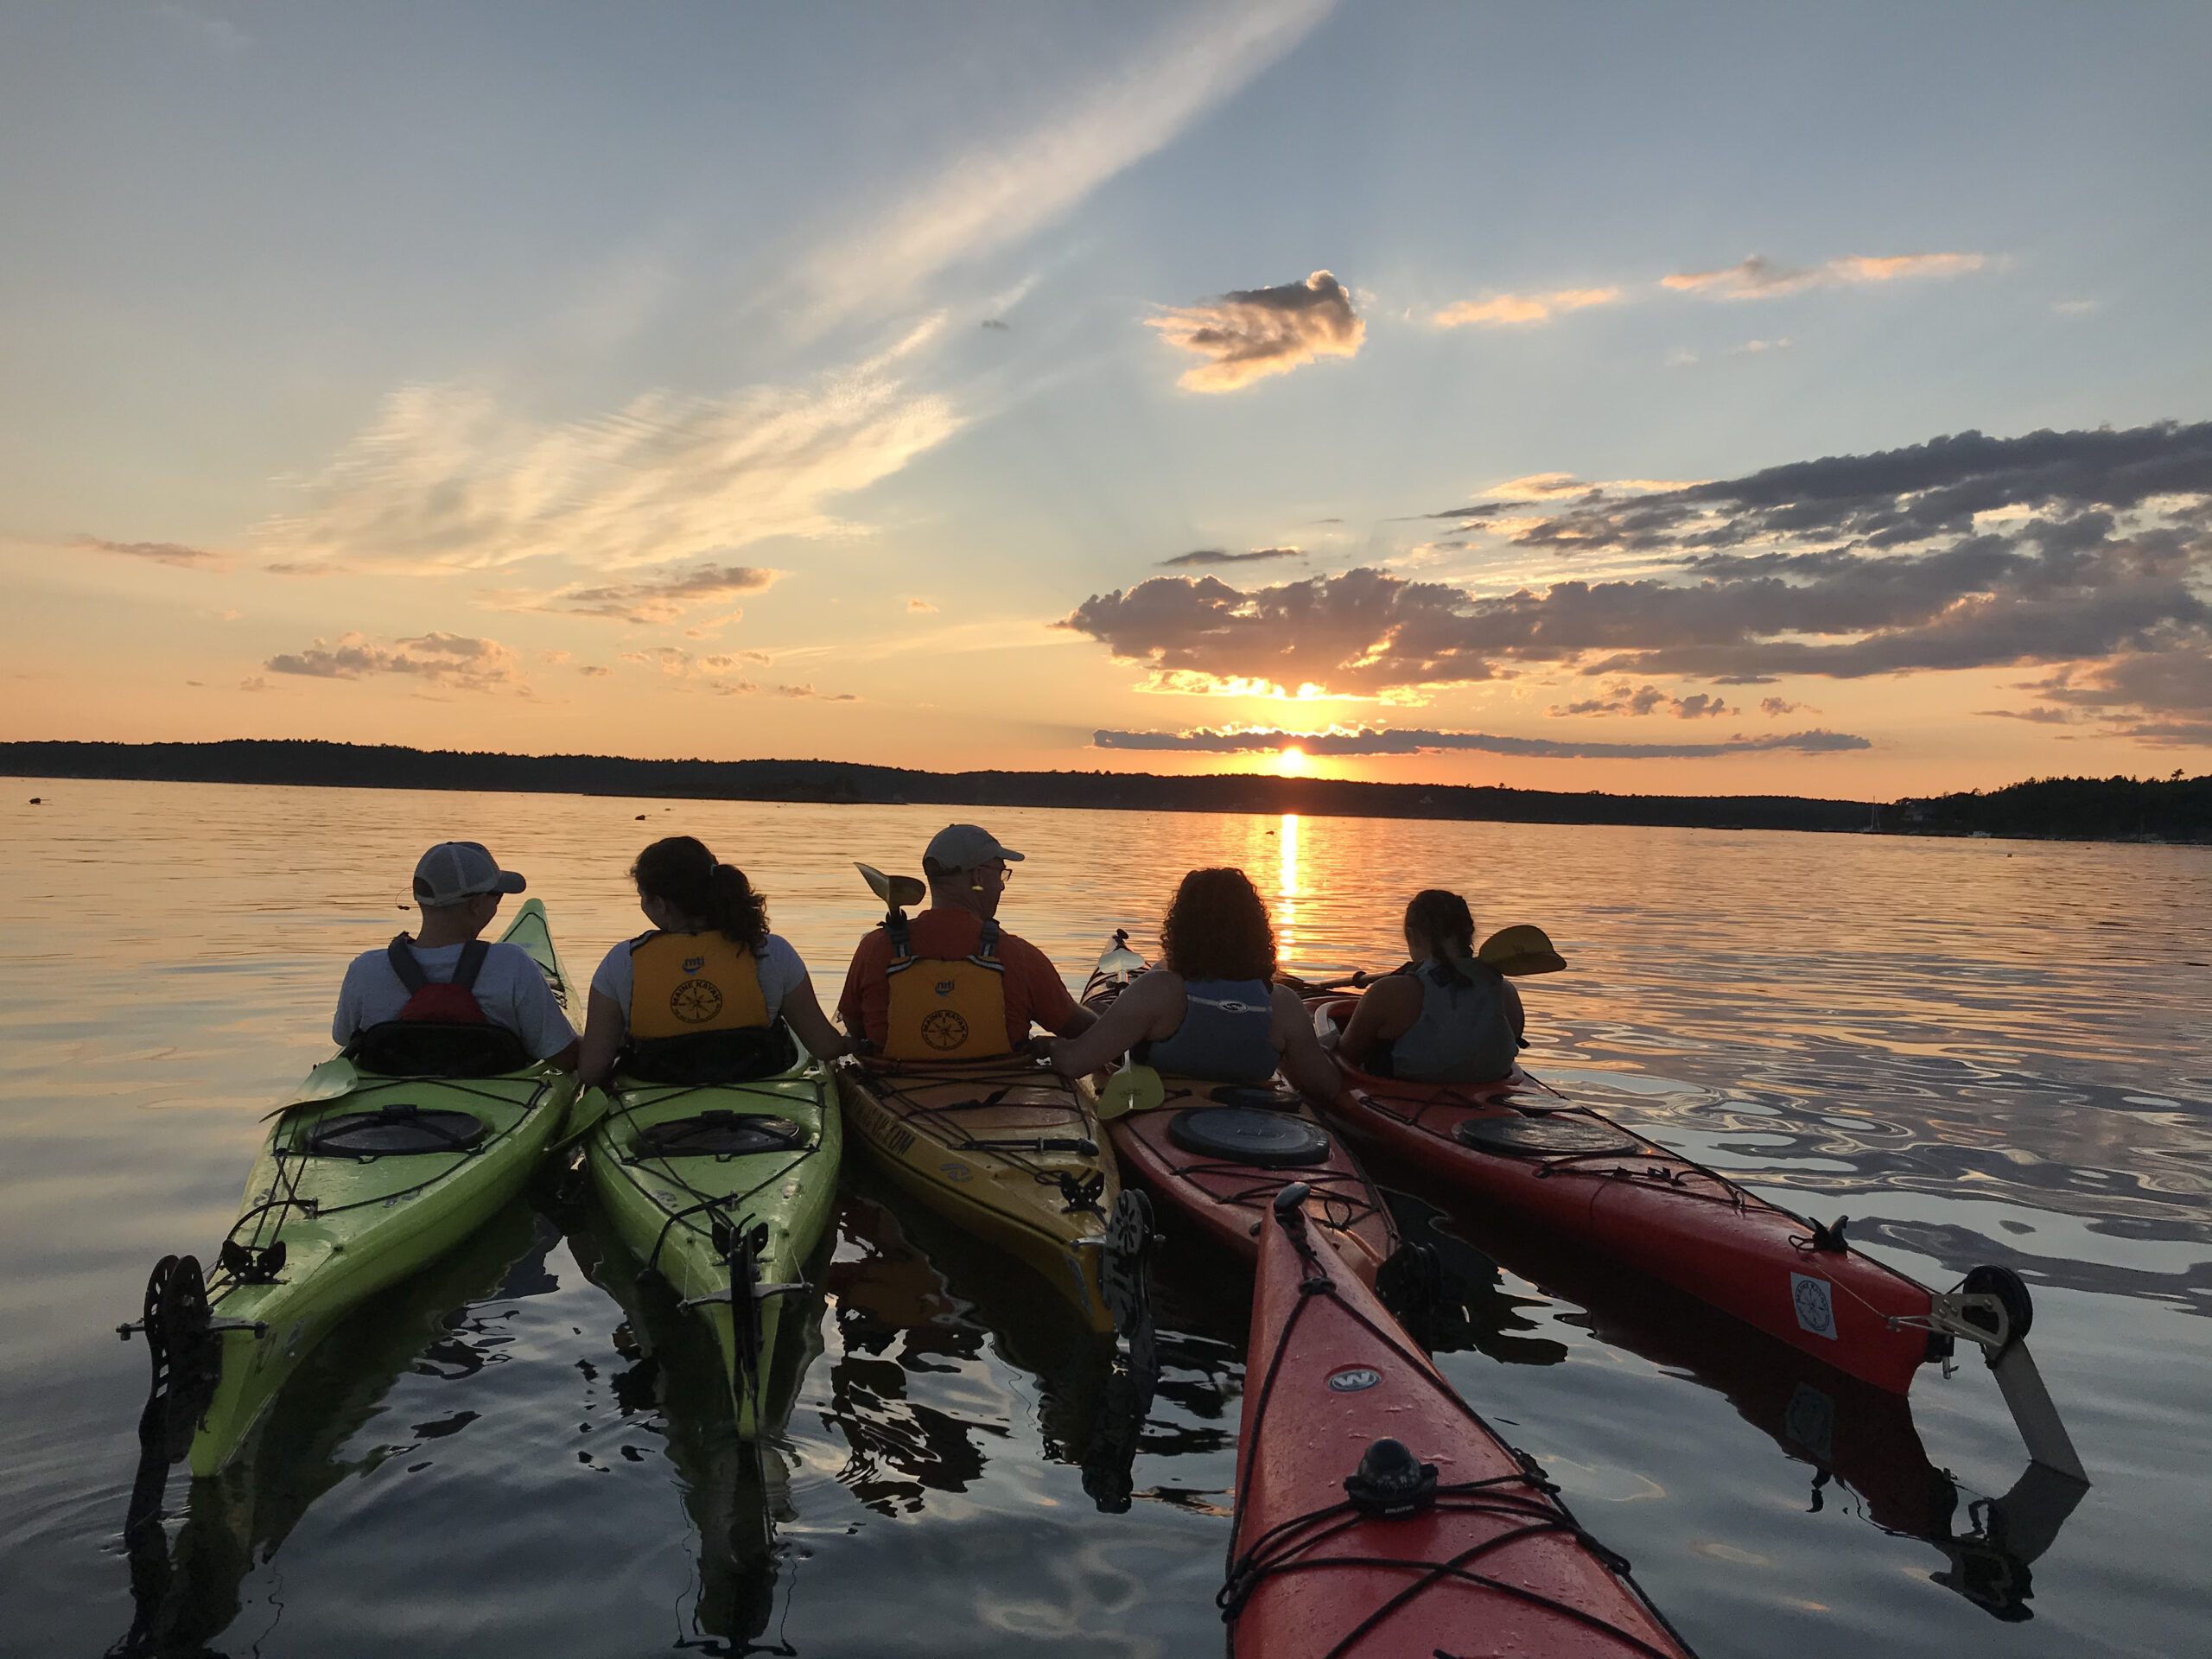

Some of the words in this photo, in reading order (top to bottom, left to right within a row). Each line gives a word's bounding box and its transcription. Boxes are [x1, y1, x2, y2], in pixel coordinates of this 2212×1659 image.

[672, 981, 693, 1007] MAINE
[696, 981, 720, 1002] KAYAK
[945, 1012, 967, 1032] KAYAK
